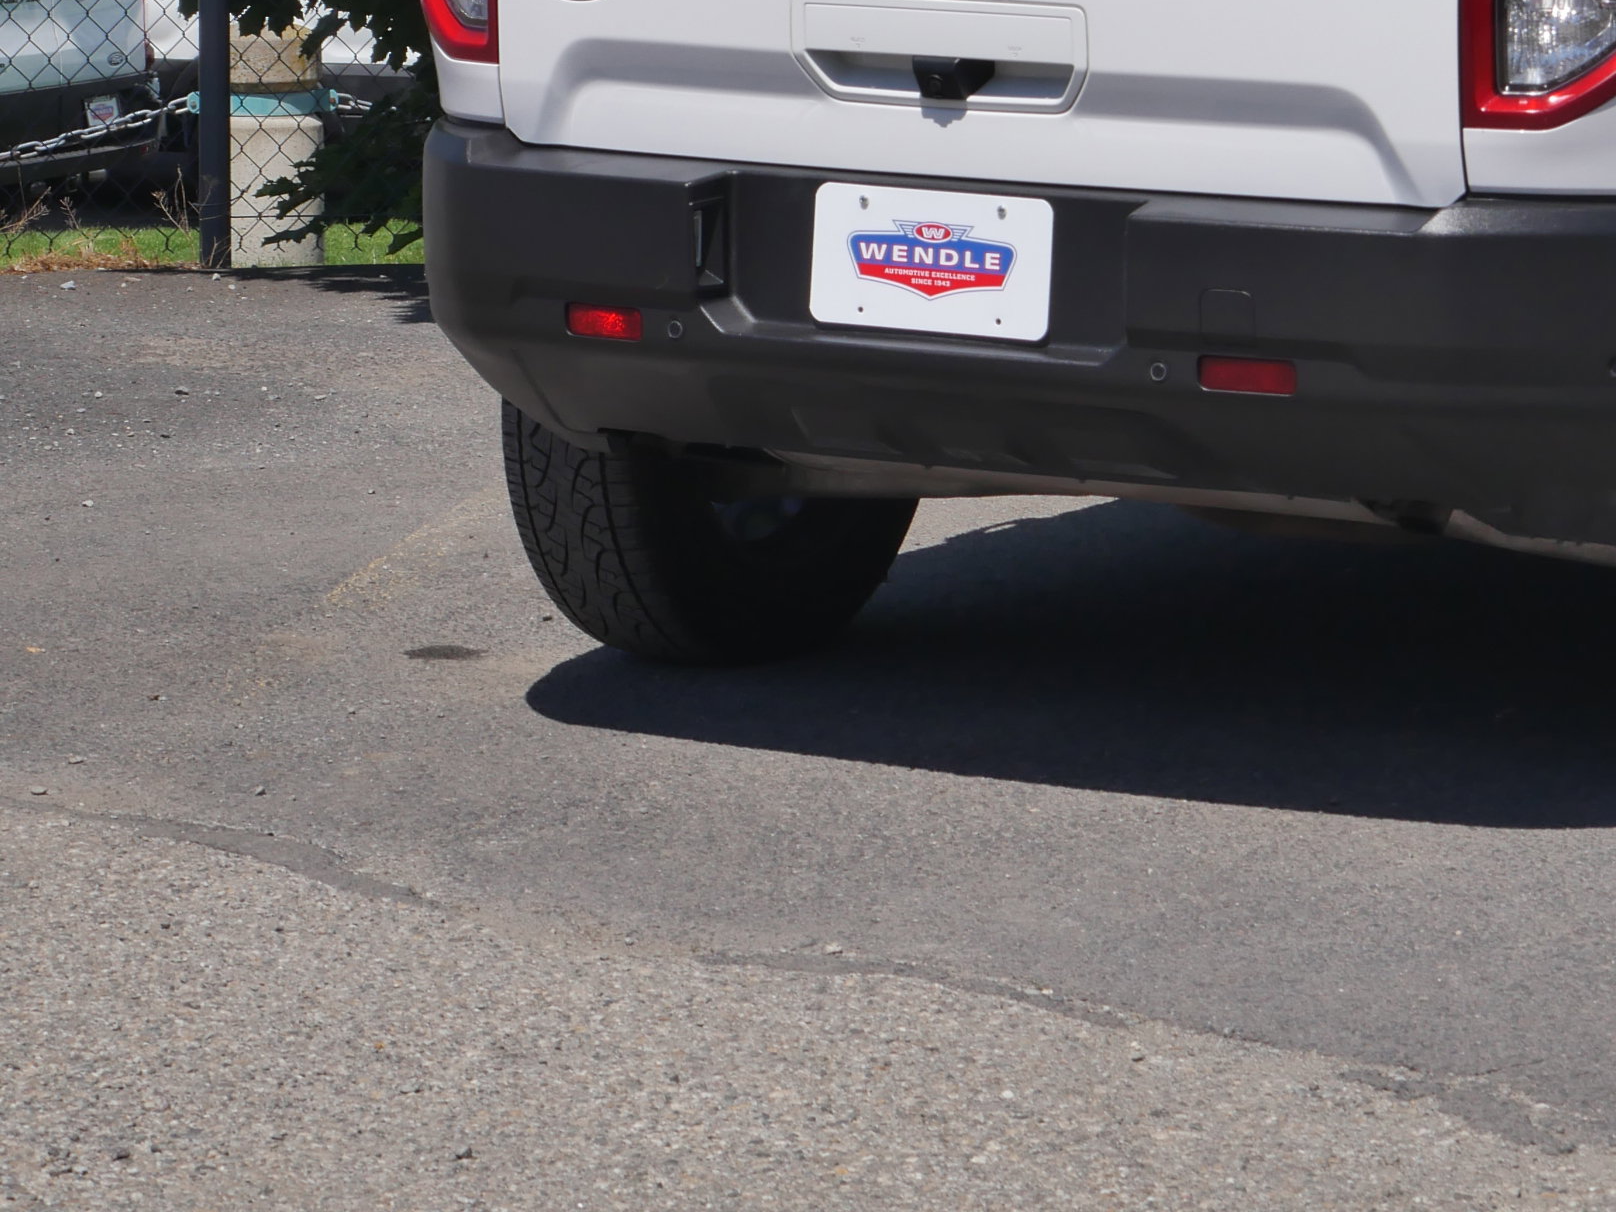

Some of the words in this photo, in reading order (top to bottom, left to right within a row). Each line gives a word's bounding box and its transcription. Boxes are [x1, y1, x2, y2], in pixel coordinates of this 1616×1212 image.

[921, 226, 946, 240] W
[859, 241, 1001, 270] WENDLE
[884, 267, 930, 278] AUTOMOTIVE
[931, 271, 976, 281] EXCELLENCE
[911, 277, 933, 286] SINCE
